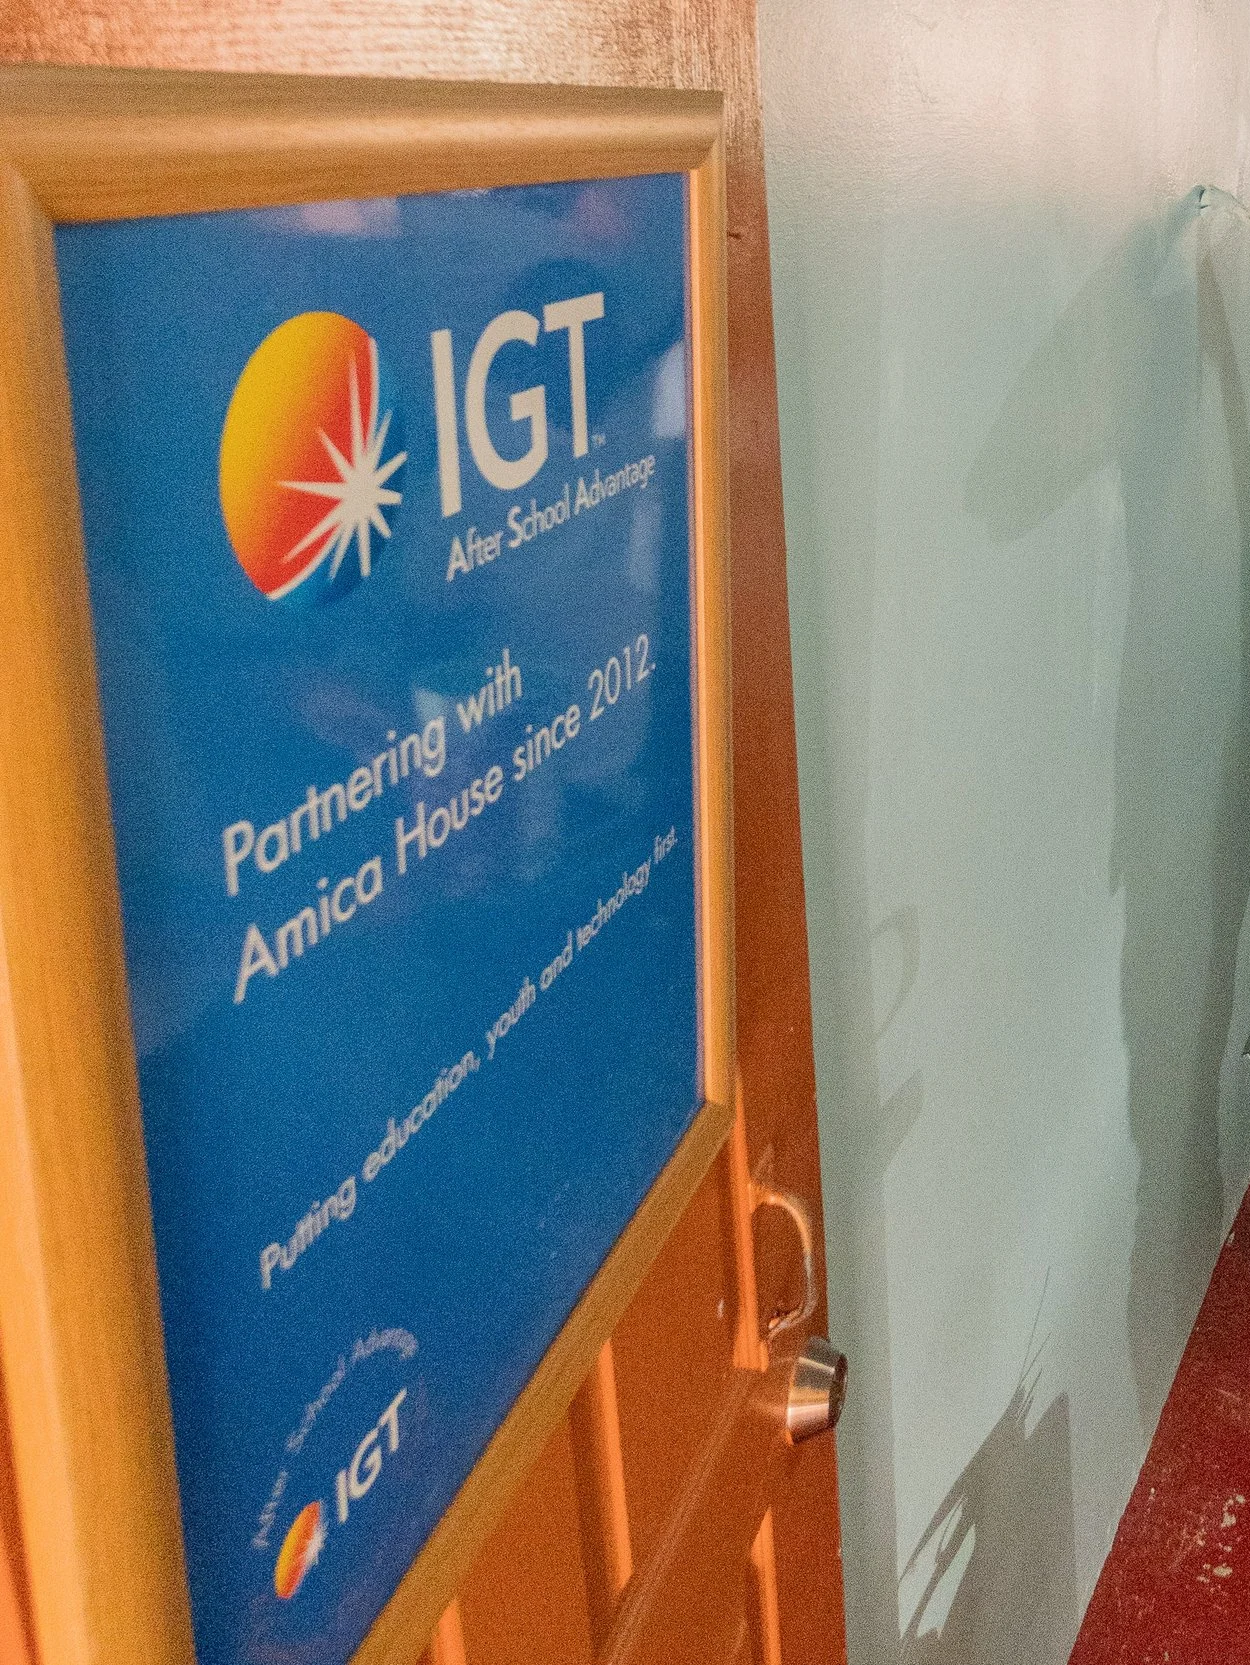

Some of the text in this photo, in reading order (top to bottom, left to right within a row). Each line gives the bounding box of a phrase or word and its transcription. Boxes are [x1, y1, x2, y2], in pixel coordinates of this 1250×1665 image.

[431, 292, 604, 518] IGT
[445, 455, 656, 582] After School Advantage
[222, 649, 523, 897] Partnering with
[233, 634, 656, 1005] Amica House since 2012.
[260, 1176, 357, 1289] Putting
[362, 1051, 481, 1182] education,
[486, 976, 536, 1061] youth
[540, 931, 573, 991] and
[576, 855, 651, 951] technology
[336, 1387, 407, 1523] IGT
